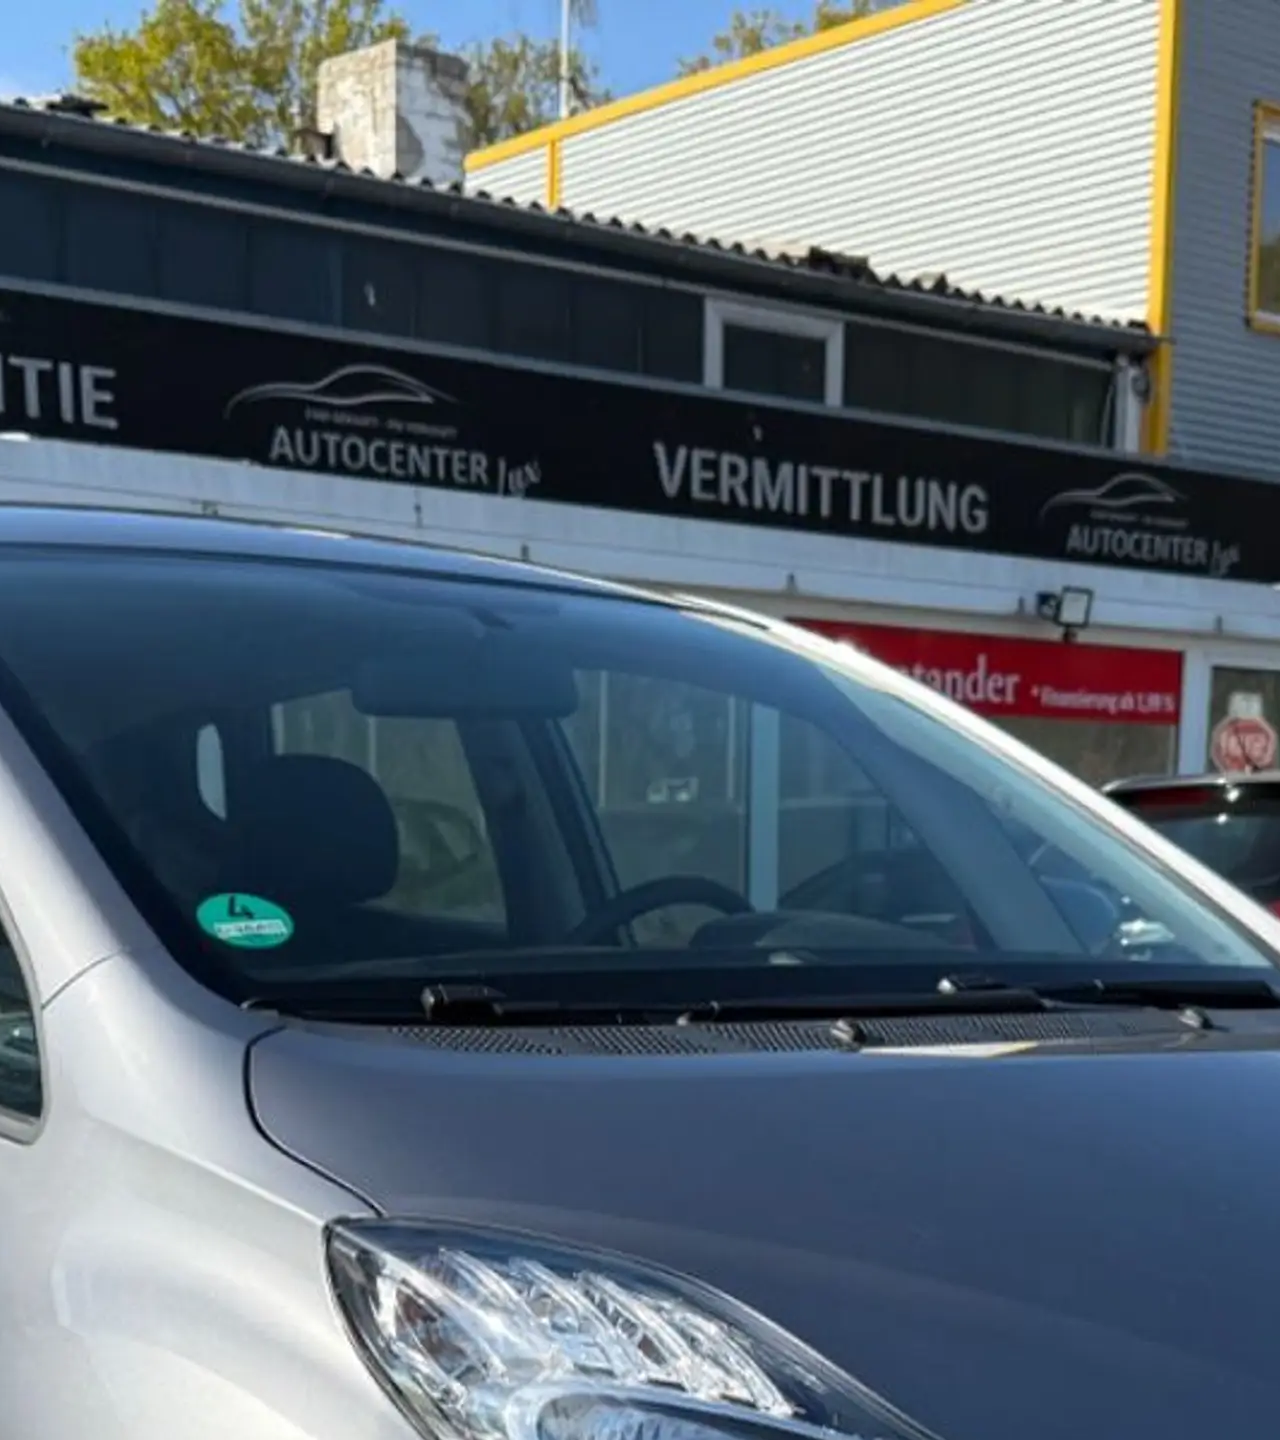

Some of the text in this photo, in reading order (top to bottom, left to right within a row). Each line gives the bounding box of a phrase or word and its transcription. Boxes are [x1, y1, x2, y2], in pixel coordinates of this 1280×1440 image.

[269, 424, 490, 485] AUTOCENTER
[652, 440, 989, 534] VERMITTLUNG
[1066, 523, 1209, 566] AUTOCENTER
